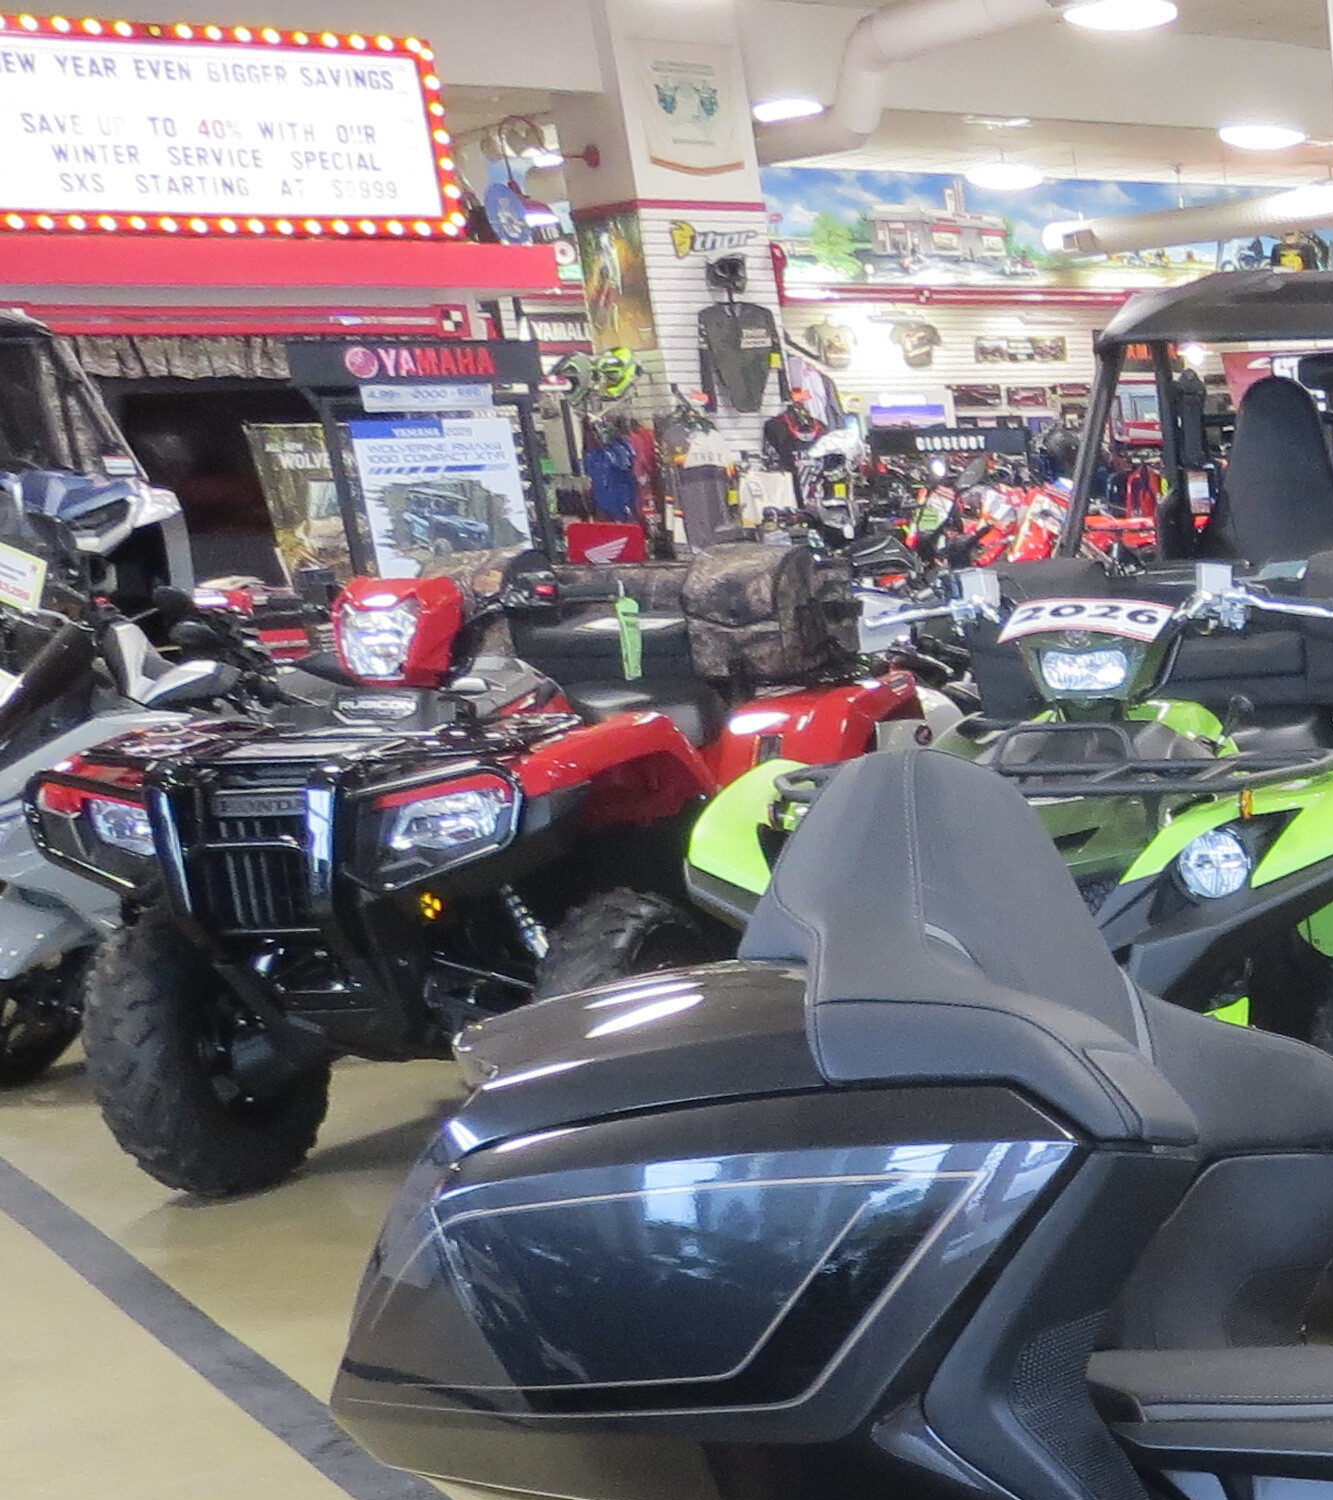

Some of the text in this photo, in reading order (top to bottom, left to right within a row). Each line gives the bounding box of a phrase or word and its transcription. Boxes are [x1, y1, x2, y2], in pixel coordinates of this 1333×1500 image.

[0, 51, 394, 90] EW YEAR EVEN BIGGER SAVINGS
[20, 112, 83, 135] SAVE
[147, 116, 177, 138] TO
[198, 119, 242, 139] 40%
[257, 121, 315, 142] WITH
[336, 124, 378, 144] OUR
[51, 143, 382, 171] WINTER SERVICE SPECIAL
[59, 172, 105, 193] SXS
[135, 174, 250, 197] STARTING
[377, 348, 497, 377] YAMAHA
[915, 435, 986, 451] CLOSEOUT
[1013, 604, 1159, 625] 2026
